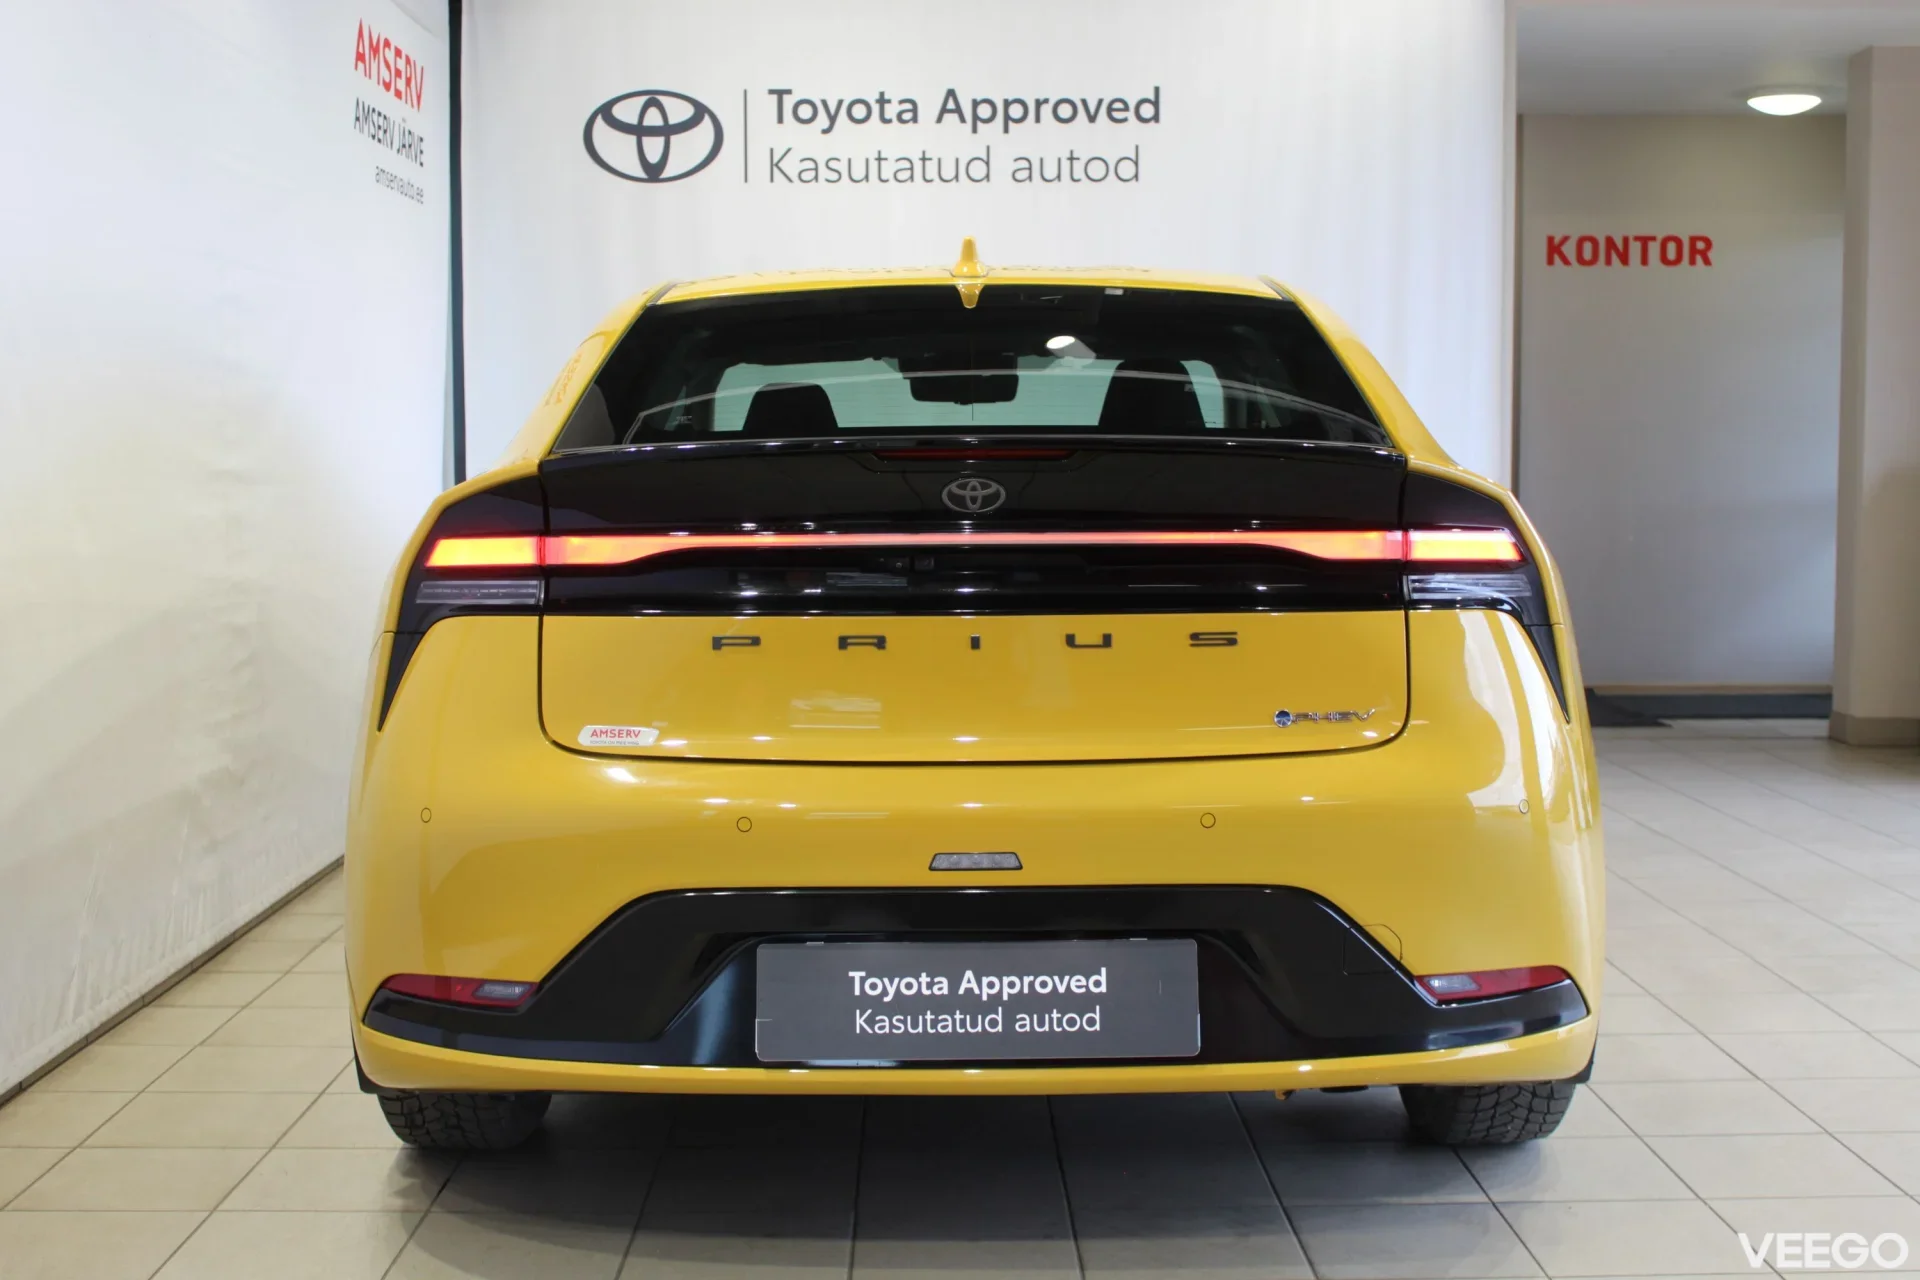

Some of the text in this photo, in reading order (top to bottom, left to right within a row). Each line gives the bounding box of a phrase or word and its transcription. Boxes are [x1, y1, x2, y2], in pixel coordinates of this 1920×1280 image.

[354, 17, 424, 112] AMSERV
[768, 86, 1161, 134] Toyota Approved
[354, 97, 424, 168] AMSERV JÄRVE
[769, 145, 1140, 183] Kasutatud autod
[375, 166, 424, 204] amservauto.ee
[1546, 235, 1713, 266] KONTOR
[712, 631, 1239, 651] PRIUS
[590, 729, 641, 738] AMSERV
[849, 967, 1107, 1002] Toyota Approved
[855, 1005, 1101, 1034] Kasutatud autod
